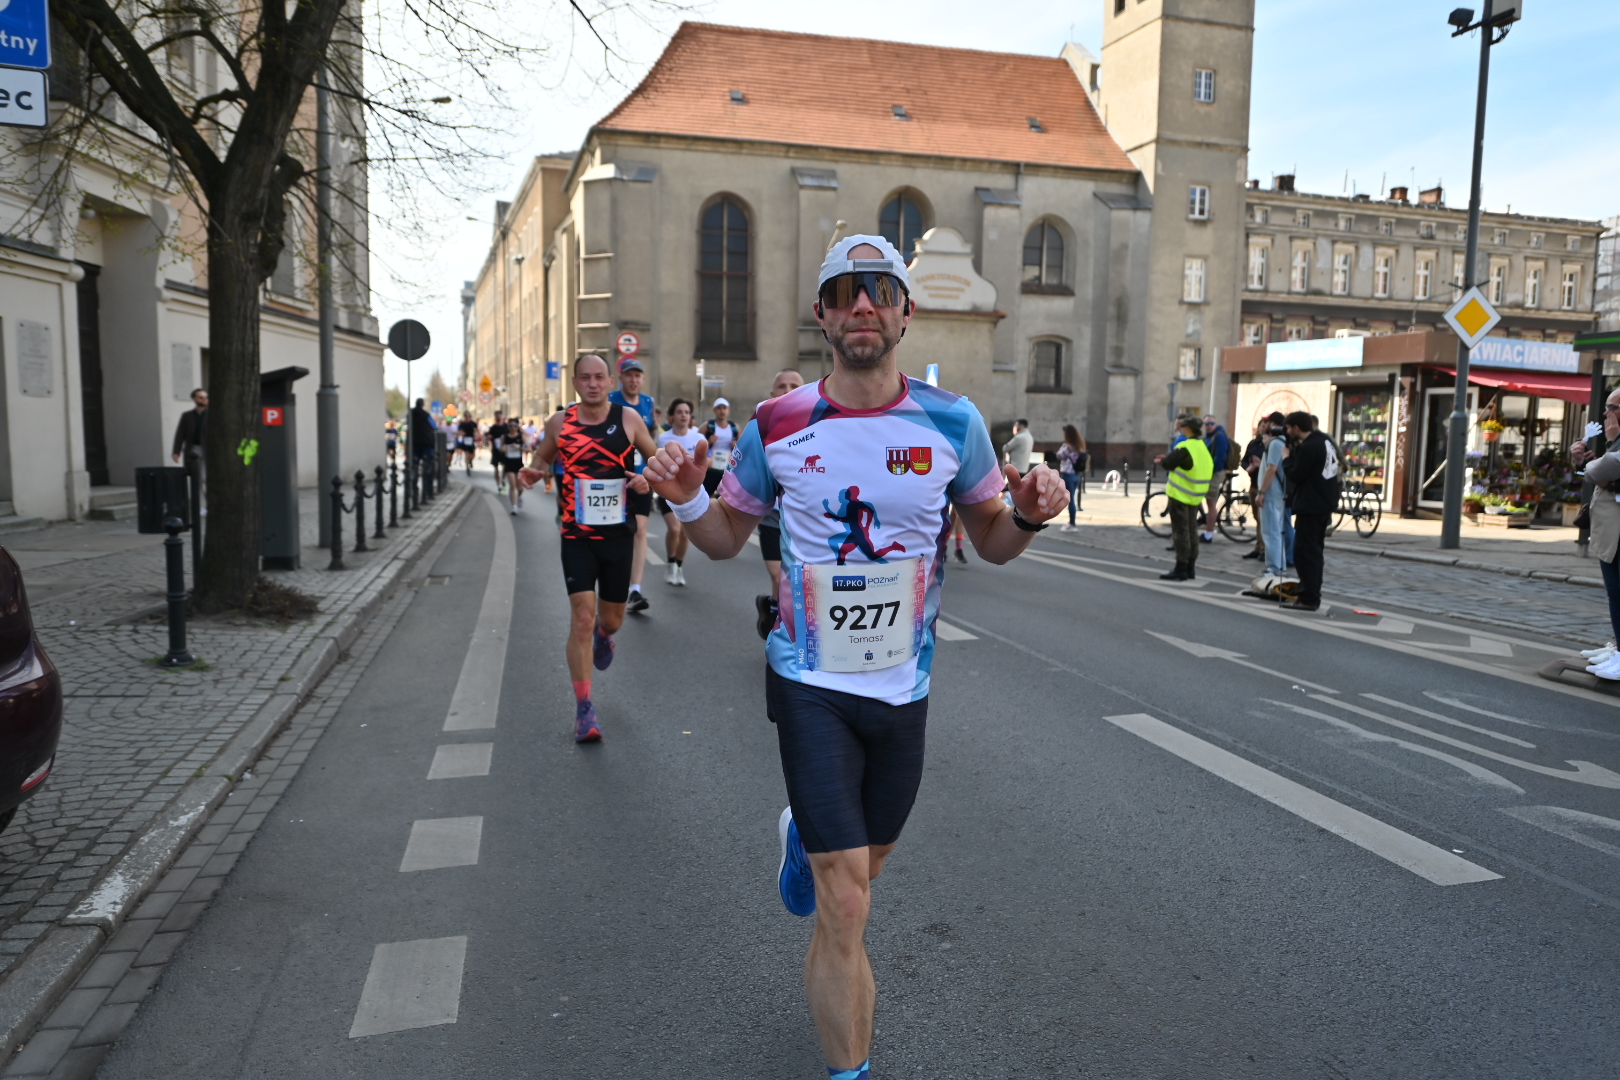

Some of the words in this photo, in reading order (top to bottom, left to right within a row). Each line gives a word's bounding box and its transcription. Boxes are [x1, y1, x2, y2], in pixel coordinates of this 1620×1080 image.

[267, 410, 279, 423] P
[787, 431, 816, 448] TOMEK
[587, 495, 619, 507] 12175
[835, 580, 863, 588] 17.PKO
[829, 601, 900, 631] 9277
[848, 635, 884, 644] Tomasz
